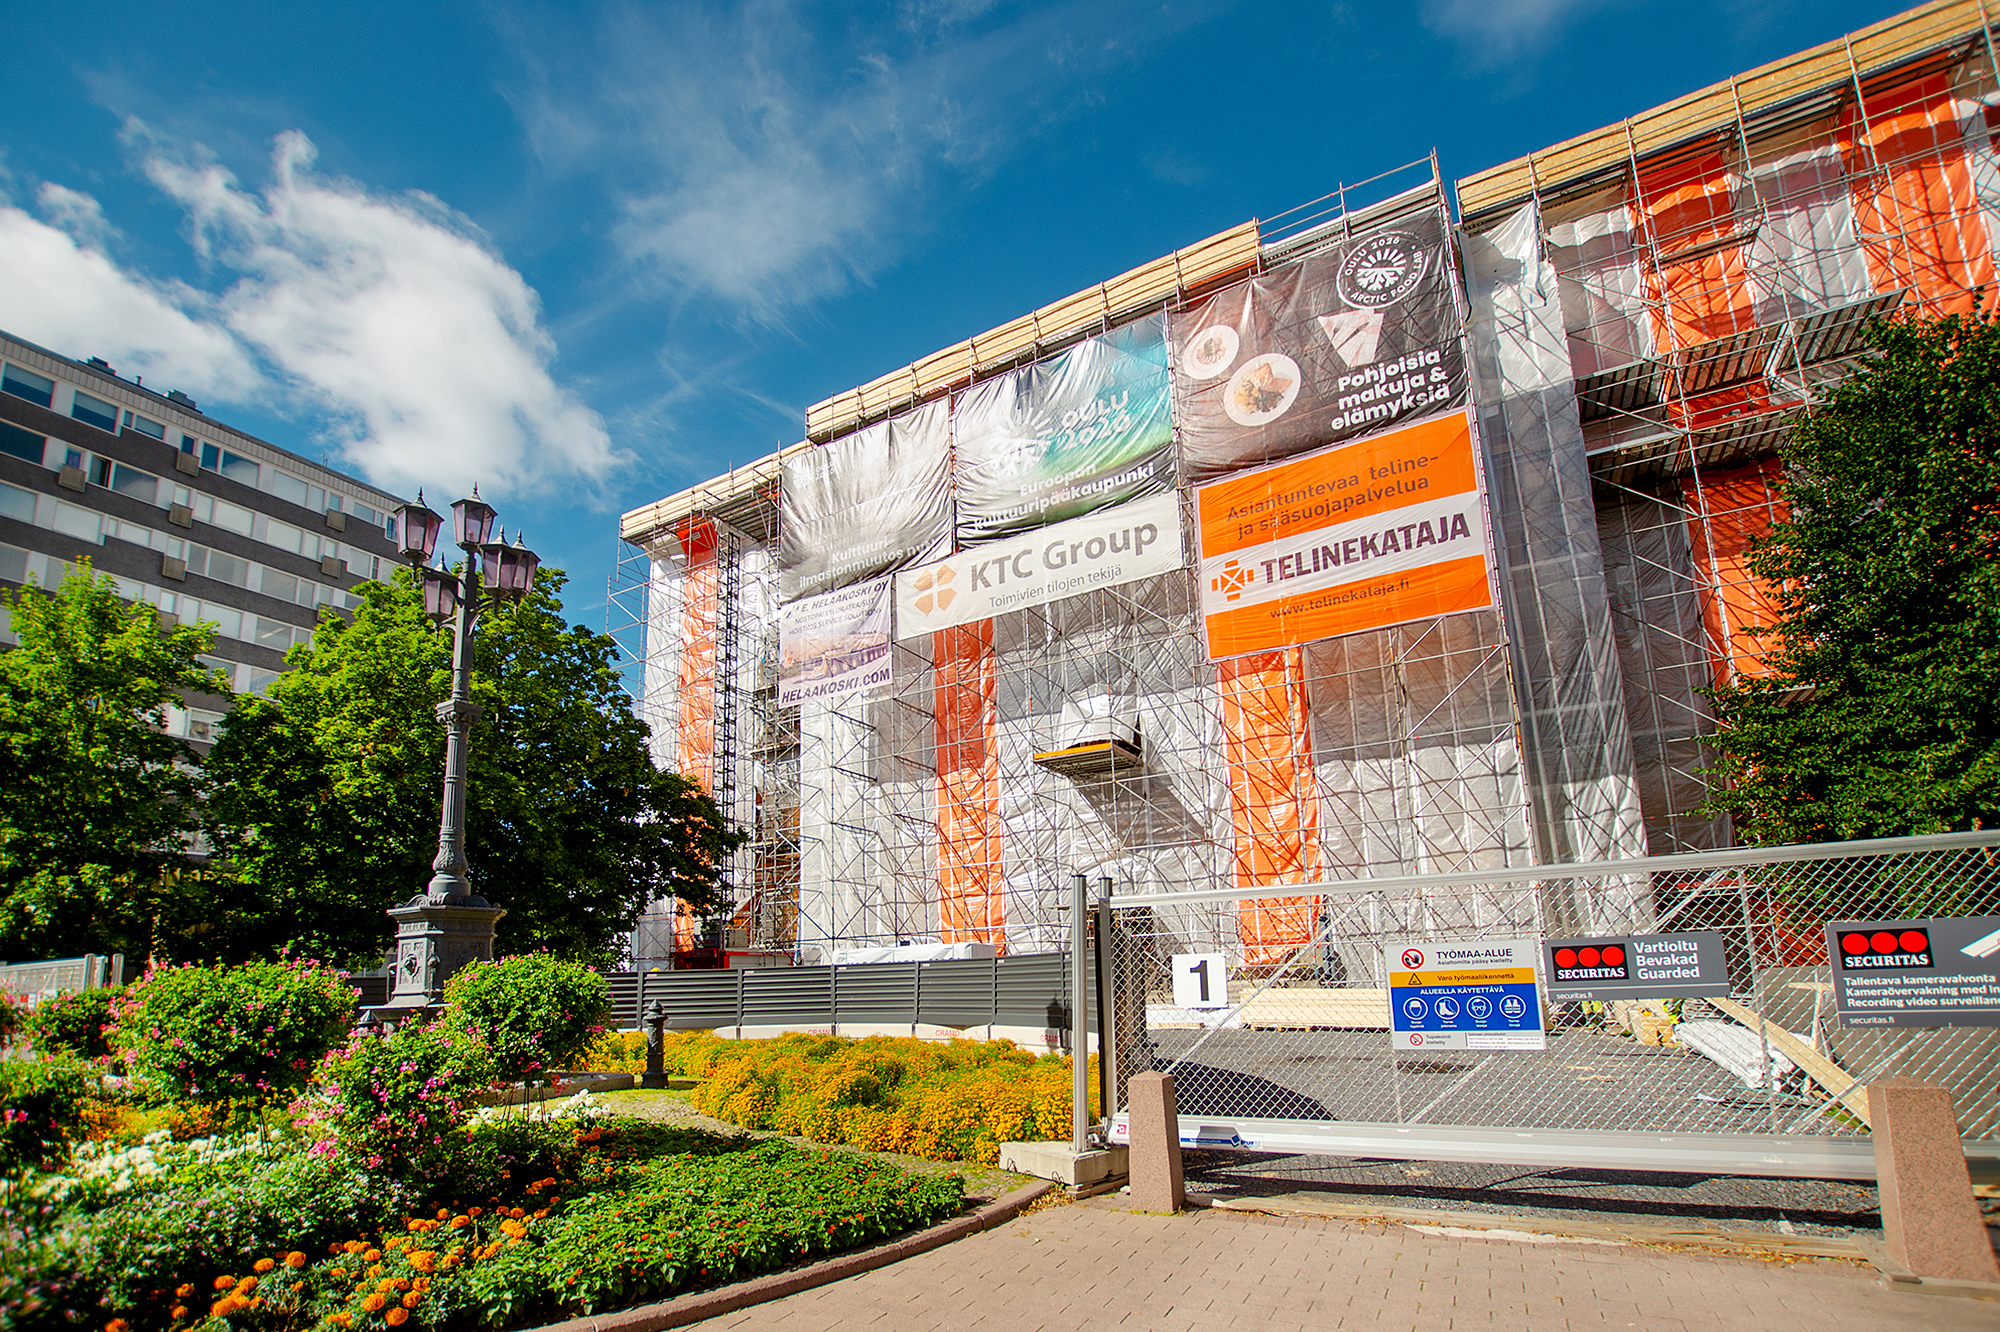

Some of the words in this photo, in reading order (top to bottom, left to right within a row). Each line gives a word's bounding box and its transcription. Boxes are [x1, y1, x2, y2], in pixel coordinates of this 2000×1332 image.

[1345, 248, 1367, 276] OULU
[1371, 236, 1400, 249] 2026
[1350, 290, 1388, 304] ARCTIC
[1390, 271, 1418, 298] FOOD
[1412, 250, 1424, 270] LAB
[1337, 350, 1441, 392] Pohjoisia
[1338, 372, 1426, 410] makuja
[1429, 366, 1449, 384] &
[1062, 390, 1129, 428] OULU
[1331, 383, 1450, 430] elämyksiä
[1063, 414, 1131, 451] 2026
[1020, 463, 1098, 497] Euroopan
[1227, 474, 1360, 522] Asiantuntevaa
[1369, 454, 1439, 480] teline-
[1238, 522, 1254, 540] ja
[1259, 475, 1430, 531] sääsuojapalvelua
[832, 536, 896, 564] Kulttuuri-
[970, 548, 1034, 592] KTC
[1042, 522, 1159, 570] Group
[1260, 512, 1471, 584] TELINEKATAJA
[799, 548, 904, 588] ilmastonmuutos
[811, 585, 871, 610] HELAAKOSKI
[873, 579, 889, 592] OY
[988, 584, 1045, 608] Toimivien
[1046, 576, 1086, 594] tilojen
[1087, 563, 1122, 583] tekijä
[1269, 578, 1410, 620] www.telinekataja.fi
[817, 617, 843, 629] SERVICE
[781, 667, 891, 704] HELAAKOSKI.COM
[1436, 948, 1514, 960] TYÖMAA-ALUE
[1471, 958, 1489, 966] pääsy
[1633, 940, 1698, 954] Vartioitu
[1635, 953, 1698, 967] Bevakad
[1844, 954, 1930, 968] SECURITAS
[1190, 960, 1210, 1001] 1
[1437, 974, 1453, 982] Varo
[1453, 972, 1515, 982] työmaaliikennettä
[1557, 967, 1626, 980] SECURITAS
[1637, 966, 1700, 980] Guarded
[1843, 977, 1901, 987] Tallentava
[1902, 974, 1997, 985] kameravalvonta
[1420, 987, 1457, 995] ALUEELLA
[1457, 985, 1505, 994] KÄYTETTÄVÄ
[1556, 991, 1593, 1000] securitas.fi
[1845, 985, 1959, 997] Kameraövervakning
[1960, 984, 1988, 994] med
[1846, 997, 1905, 1008] Recording
[1905, 996, 1938, 1006] video
[935, 1029, 961, 1037] CRAMO
[1849, 1016, 1895, 1024] securitas.fi
